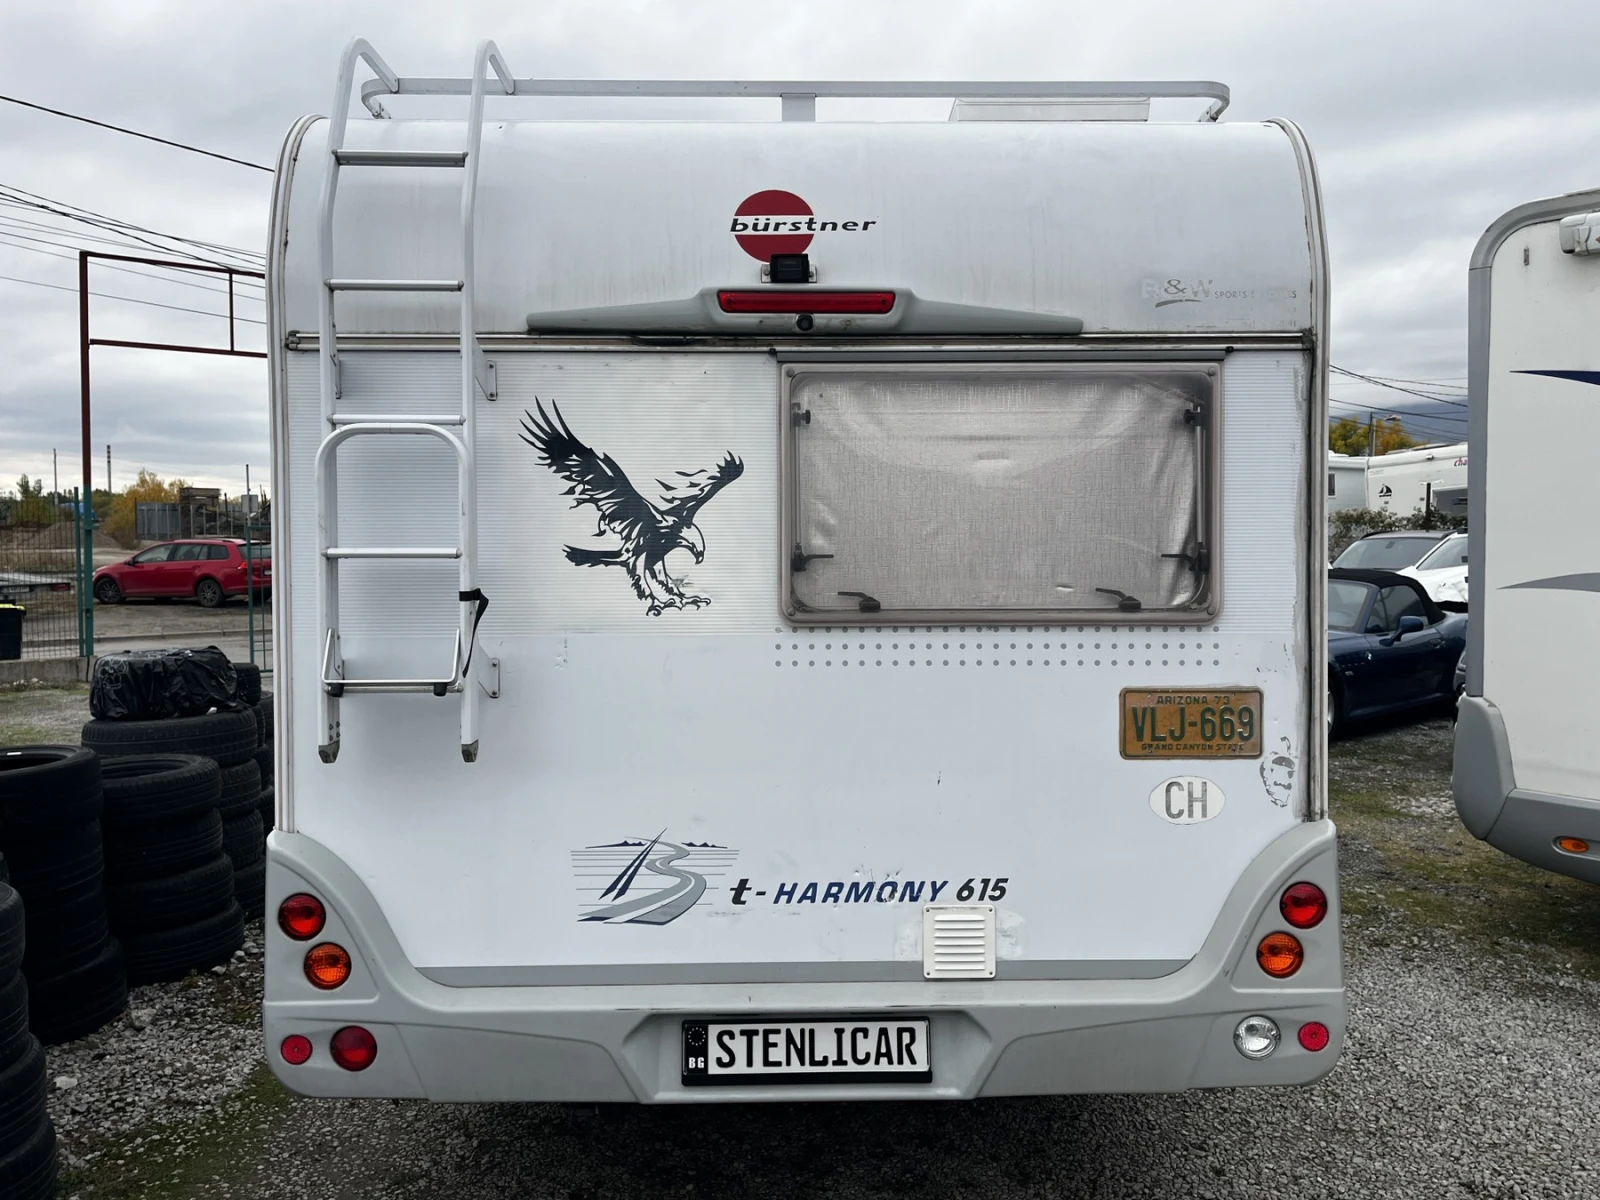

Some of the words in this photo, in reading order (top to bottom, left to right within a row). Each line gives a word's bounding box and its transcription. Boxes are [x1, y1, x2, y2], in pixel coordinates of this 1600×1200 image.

[730, 217, 877, 232] bürstner
[1156, 695, 1208, 705] ARIZONA
[1214, 694, 1230, 705] 73
[1131, 706, 1254, 742] VLJ-669
[1142, 743, 1174, 751] GRAND
[1176, 743, 1213, 751] CANYON
[1215, 742, 1245, 751] STATE
[1165, 781, 1208, 819] CH
[955, 877, 1009, 902] 615
[715, 1027, 918, 1068] STENLICAR
[688, 1056, 705, 1069] BG
